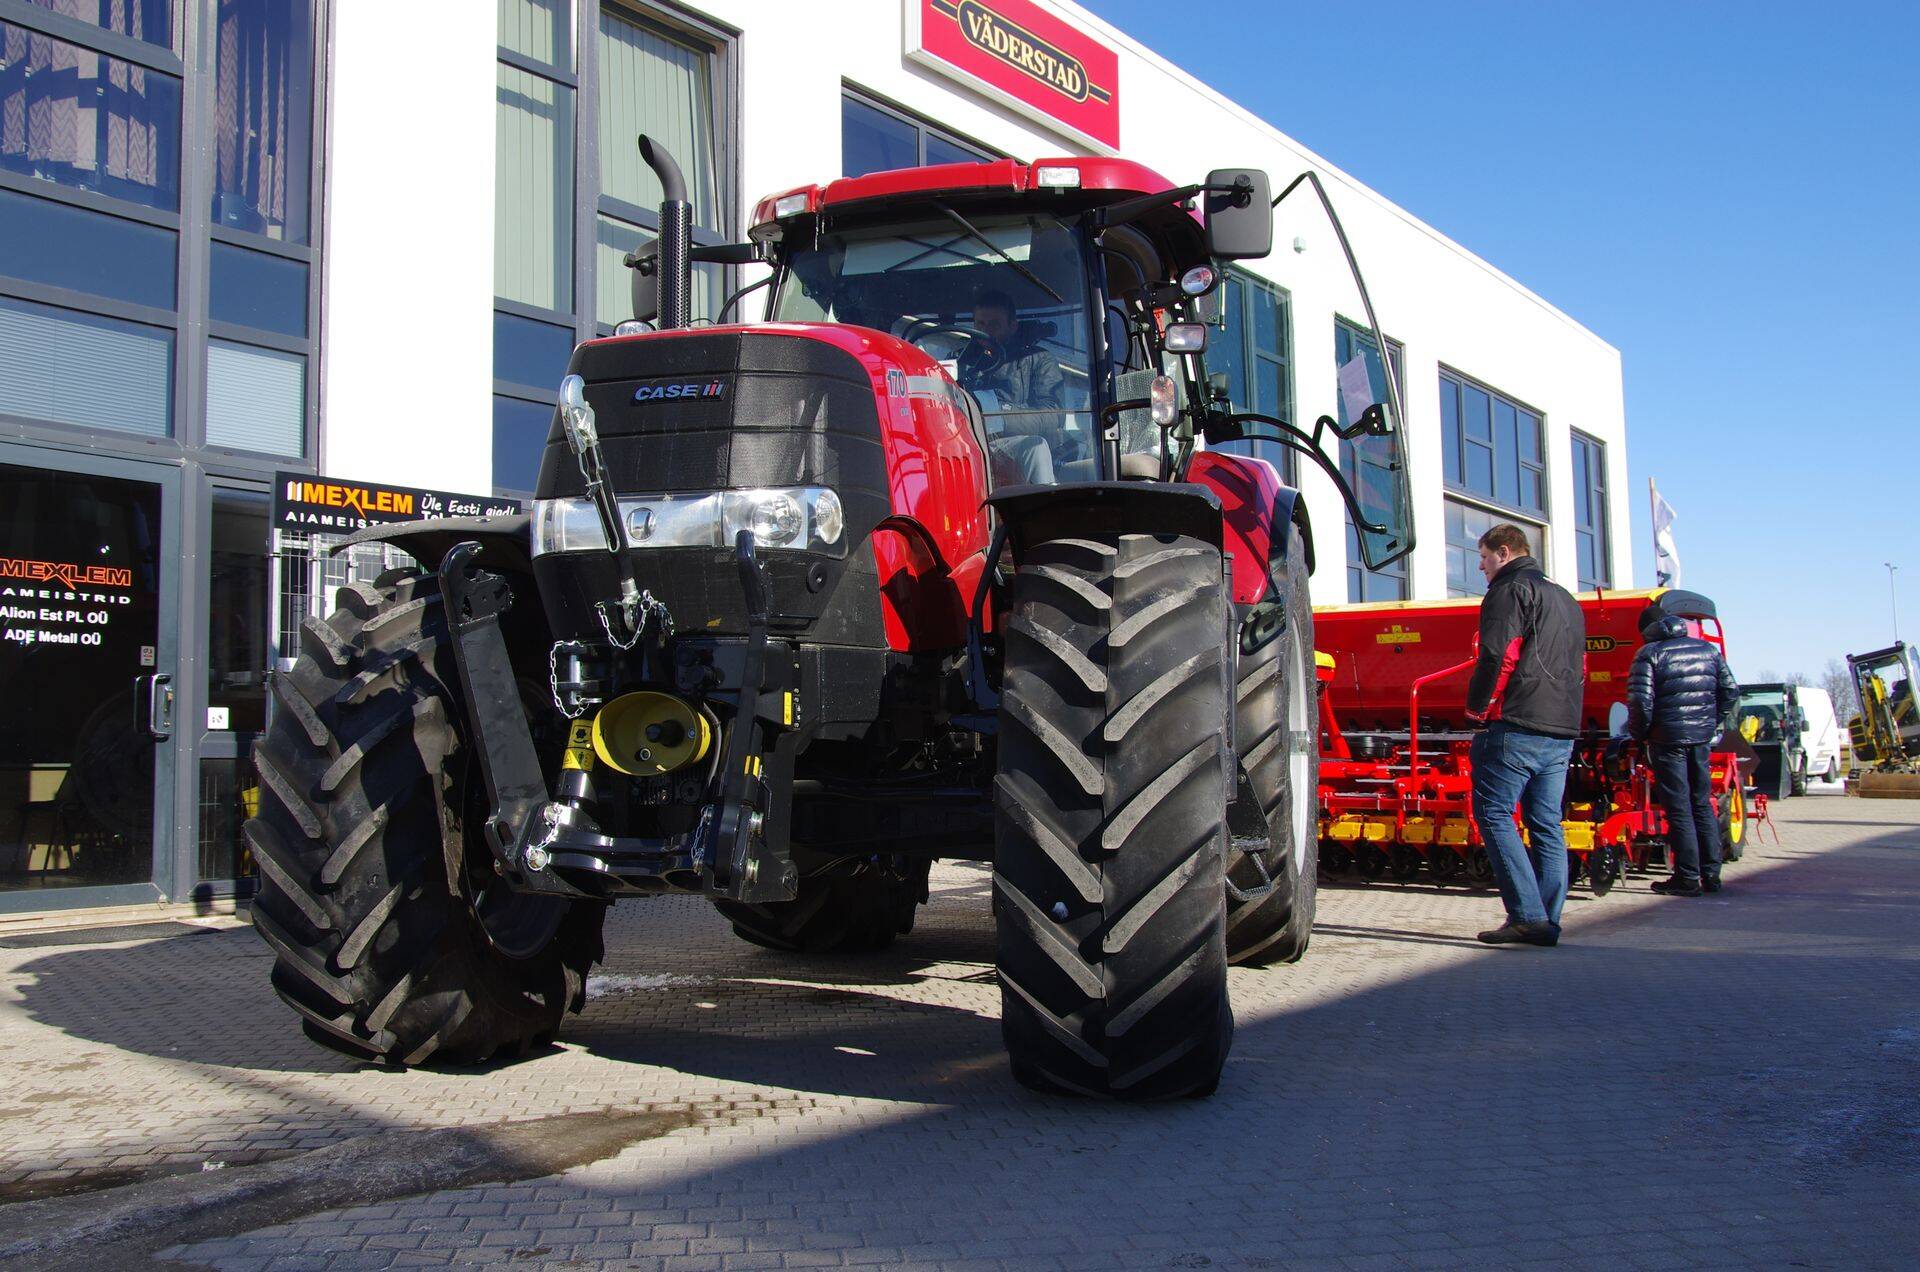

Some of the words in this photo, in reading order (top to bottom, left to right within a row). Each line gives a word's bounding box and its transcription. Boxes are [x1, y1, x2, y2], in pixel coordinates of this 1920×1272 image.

[967, 9, 1082, 95] VÄDERSTAD
[635, 384, 698, 401] CASE
[303, 482, 414, 519] MEXLEM
[420, 493, 442, 511] Üle
[448, 500, 481, 515] Eesti
[0, 558, 132, 590] MEXLEM
[39, 608, 62, 622] Est
[66, 611, 84, 623] PL
[87, 611, 108, 625] OÜ
[38, 630, 78, 644] Metall
[80, 632, 101, 646] OÜ
